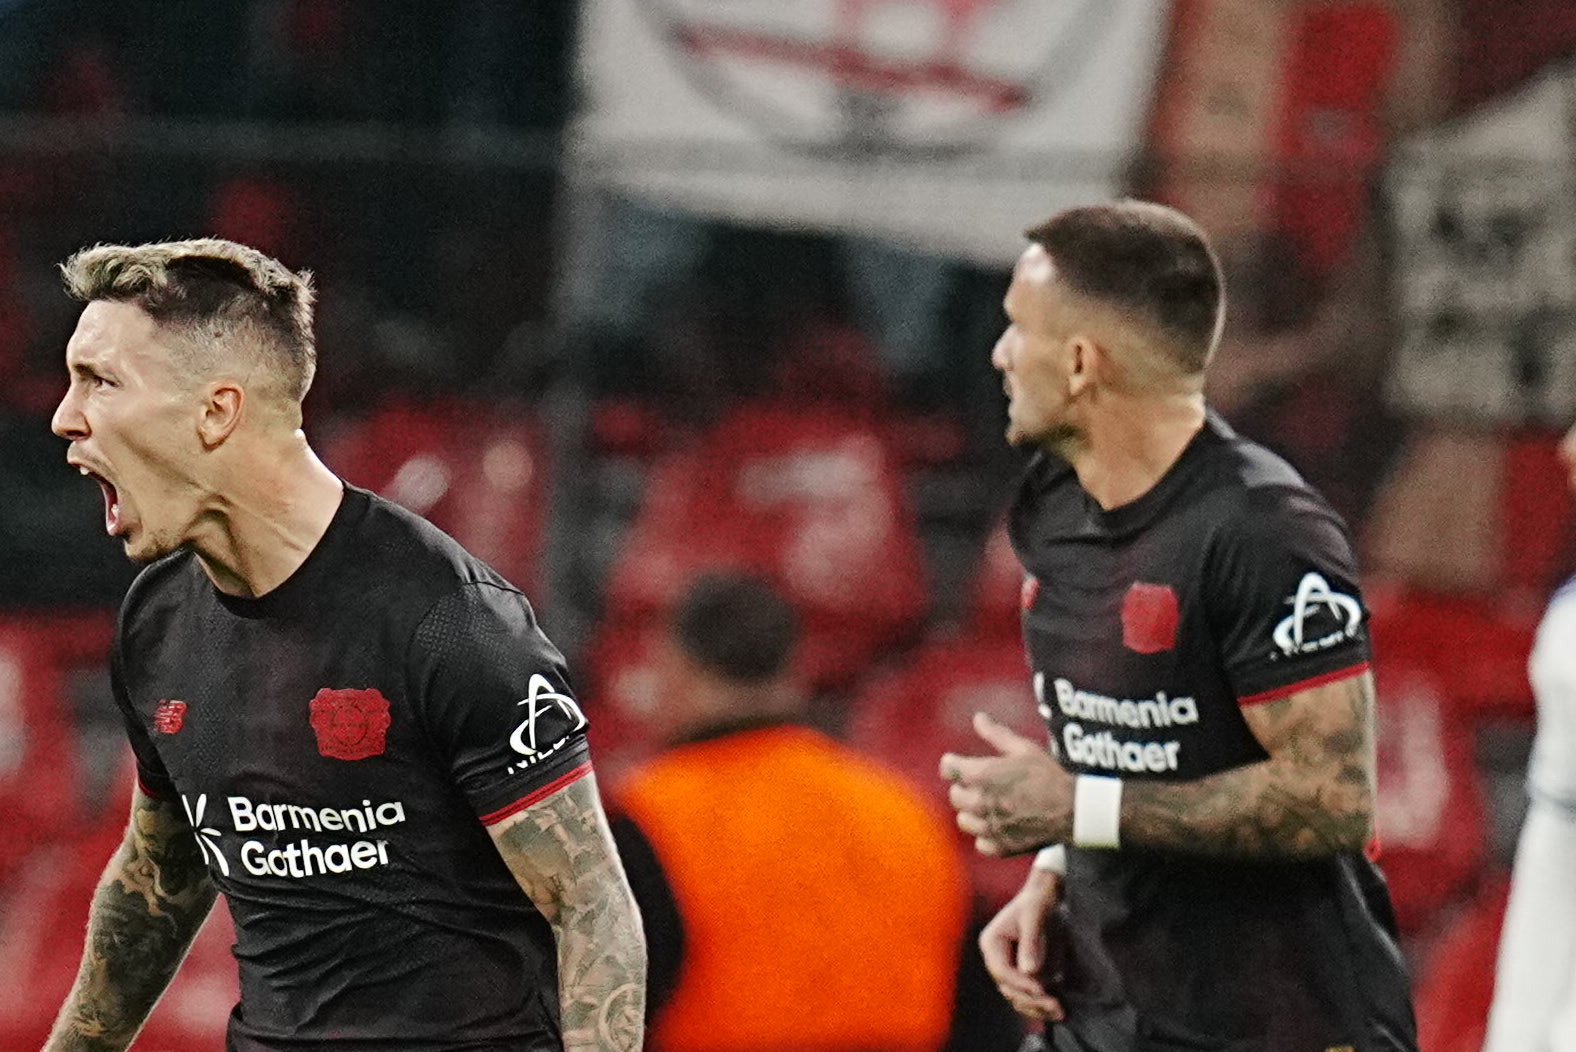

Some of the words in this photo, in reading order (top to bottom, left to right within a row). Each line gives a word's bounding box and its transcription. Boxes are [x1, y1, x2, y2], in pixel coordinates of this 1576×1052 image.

[1054, 678, 1199, 729] Barmenia
[1063, 722, 1181, 772] Gothaer
[227, 796, 406, 833] Barmenia
[240, 838, 390, 878] Gothaer
